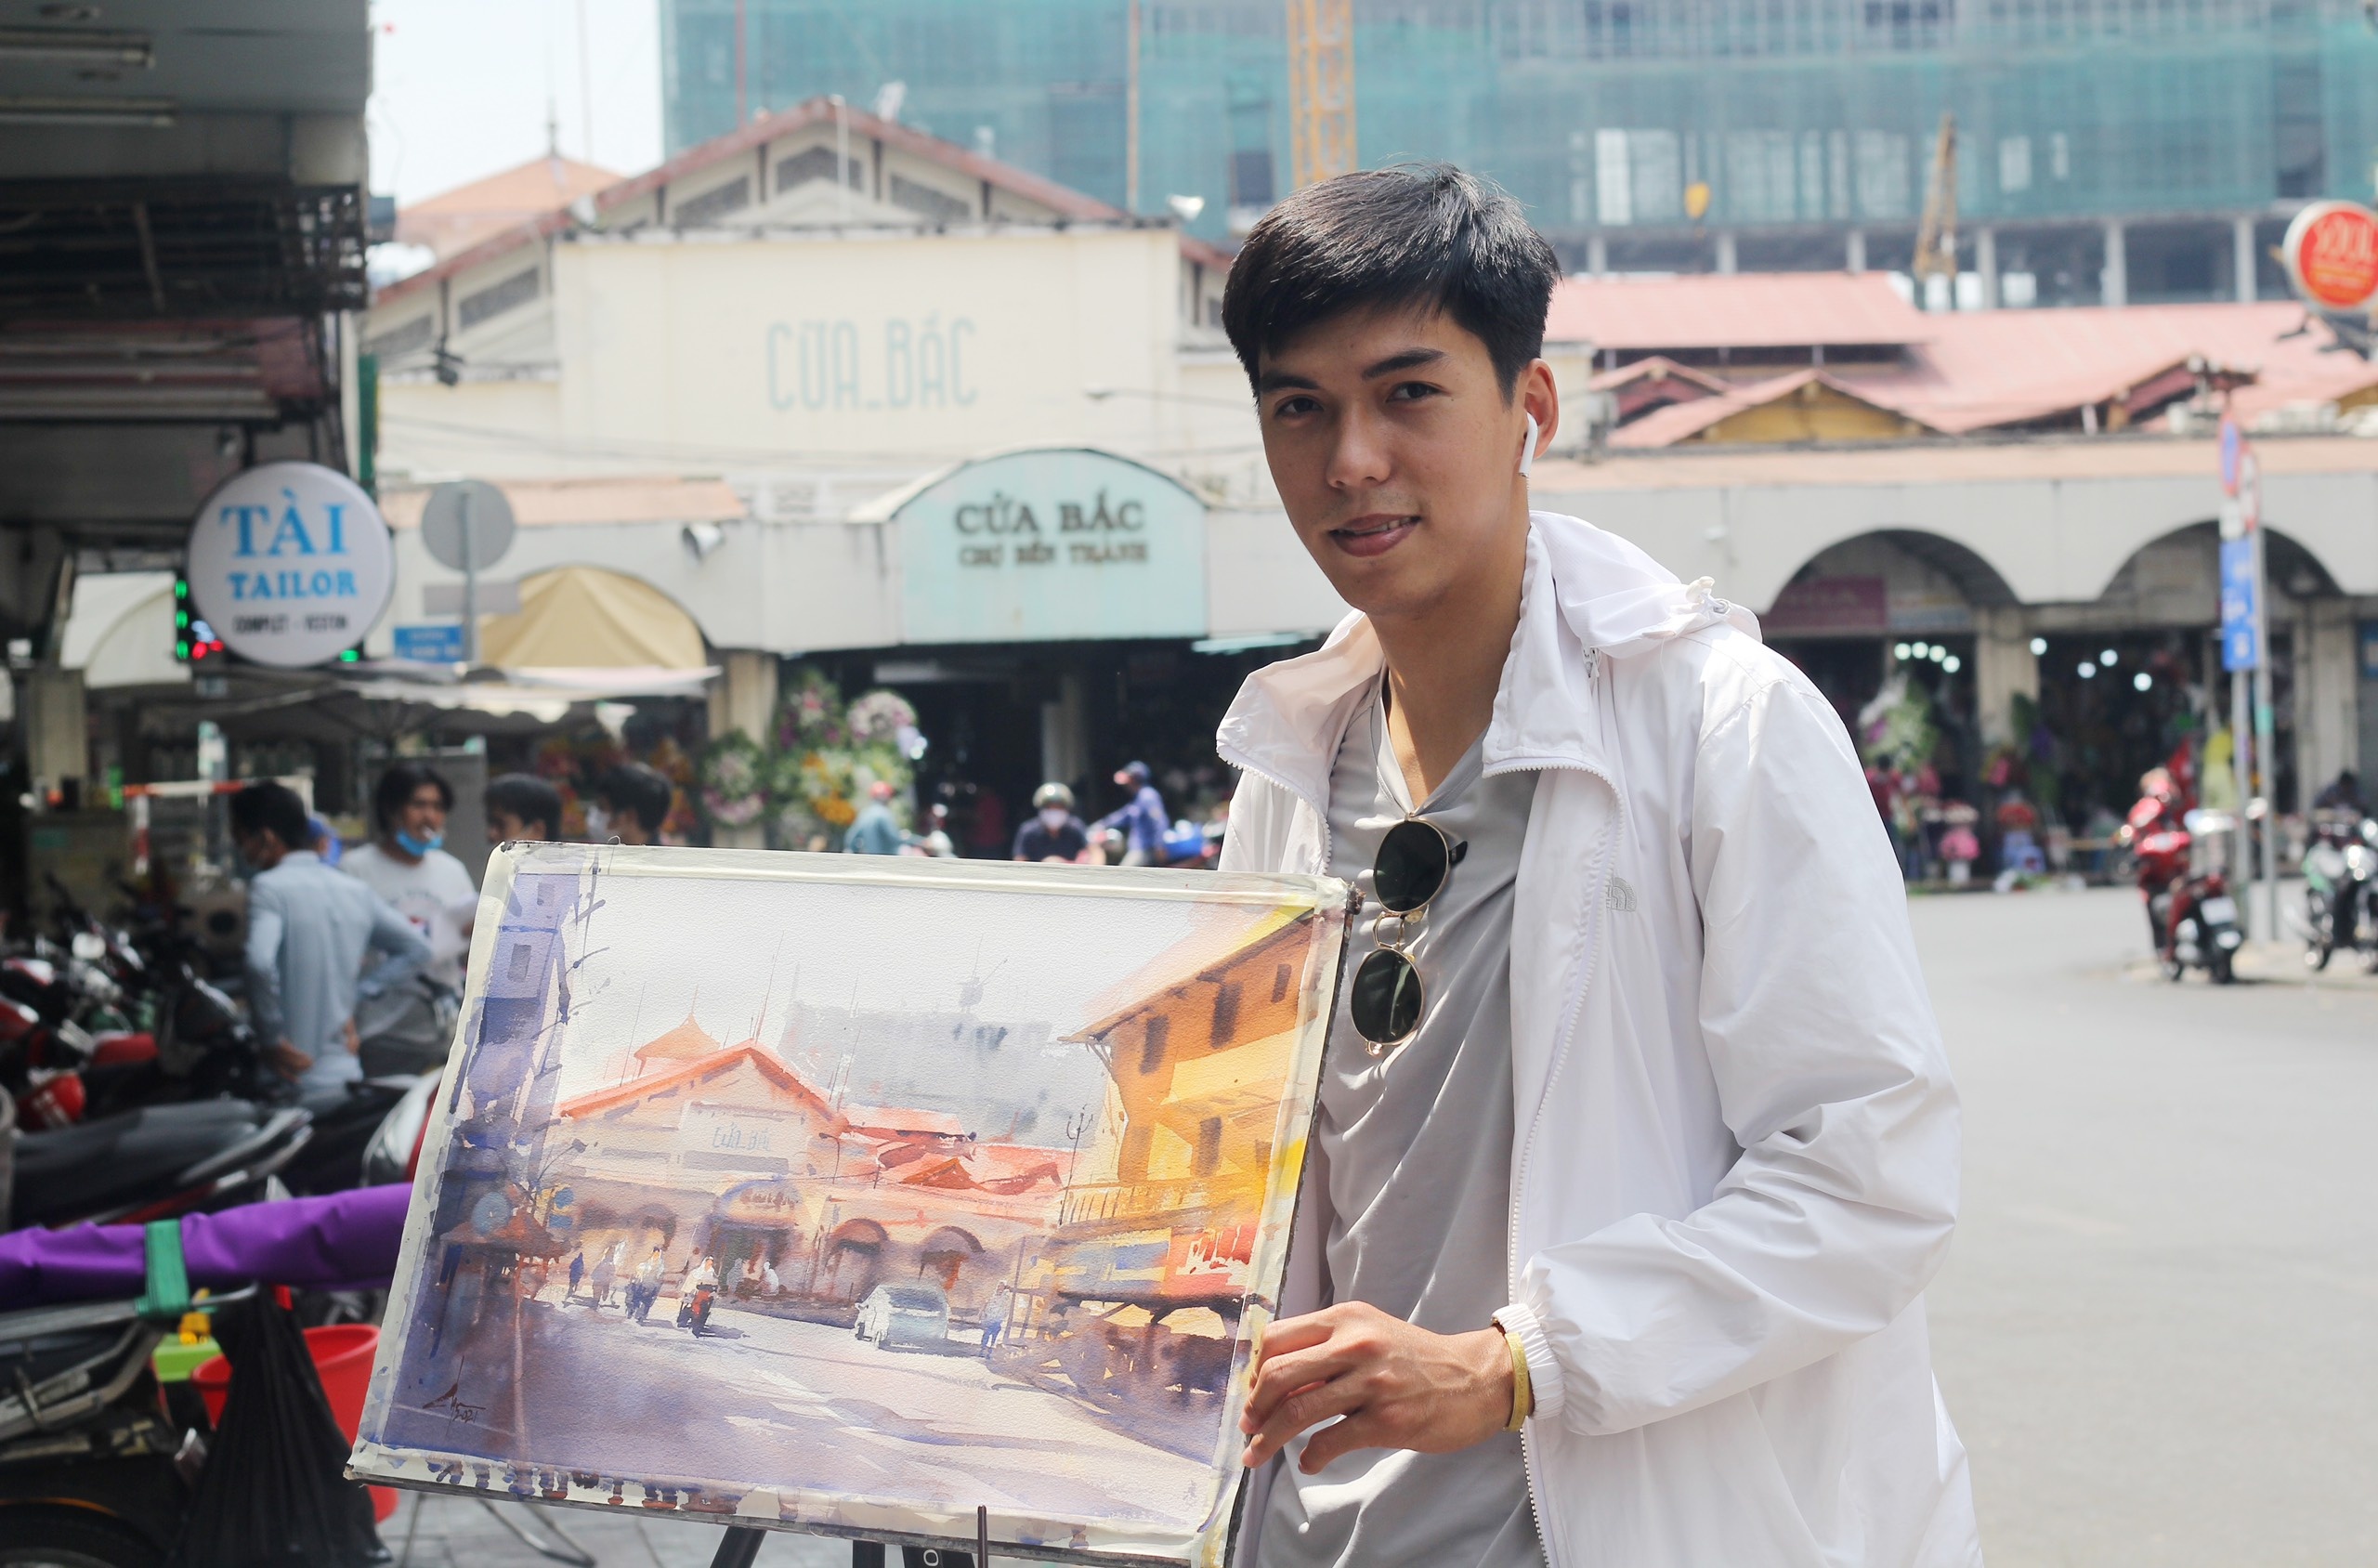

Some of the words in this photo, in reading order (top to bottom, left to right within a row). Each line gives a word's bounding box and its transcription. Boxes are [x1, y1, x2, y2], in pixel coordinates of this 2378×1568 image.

[219, 487, 348, 557] TÀI
[956, 490, 1039, 534] CỬA
[1059, 487, 1143, 532] BẮC
[228, 570, 358, 601] TAILOR
